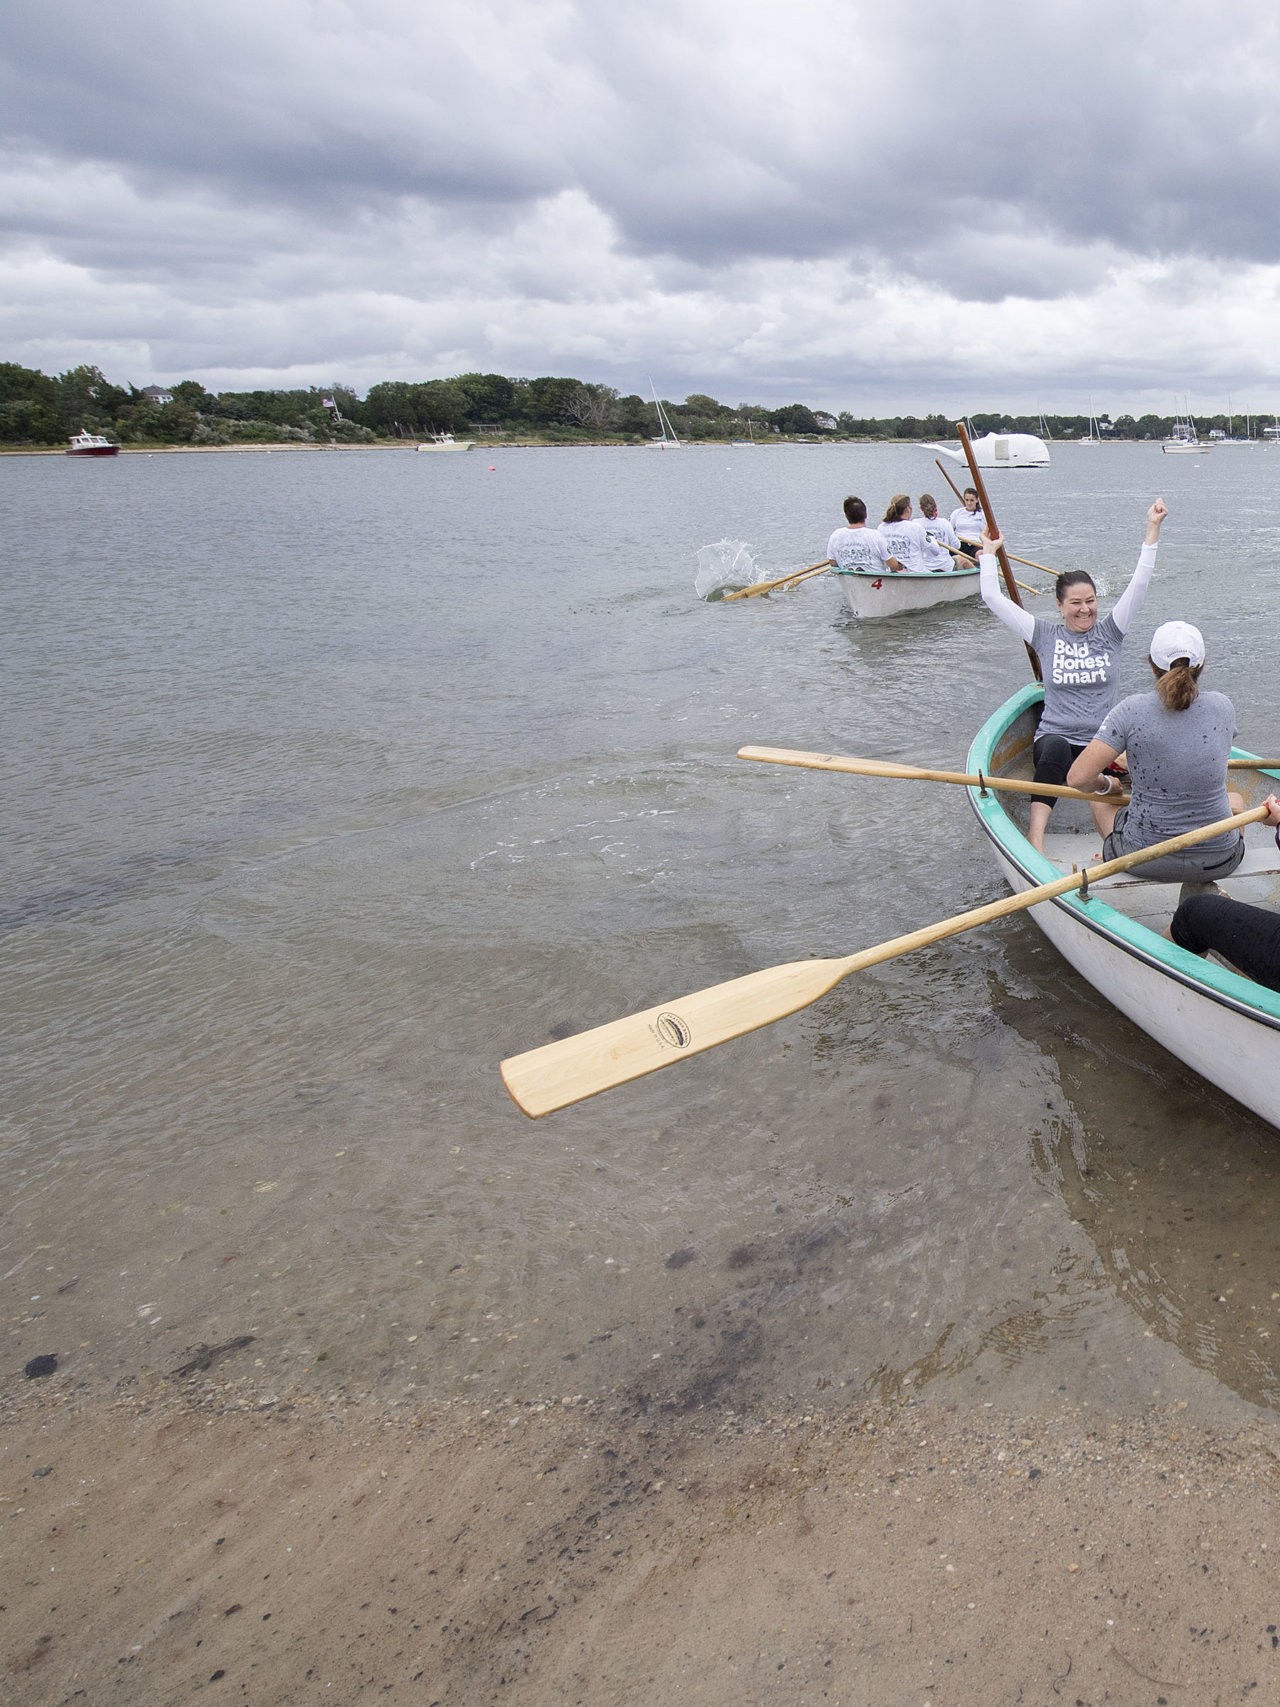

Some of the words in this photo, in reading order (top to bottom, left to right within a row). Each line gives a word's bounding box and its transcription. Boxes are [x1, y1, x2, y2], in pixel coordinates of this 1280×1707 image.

[871, 578, 882, 590] 4
[1056, 639, 1089, 658] Bold
[1052, 653, 1111, 669] Honest
[1052, 669, 1107, 684] Smart
